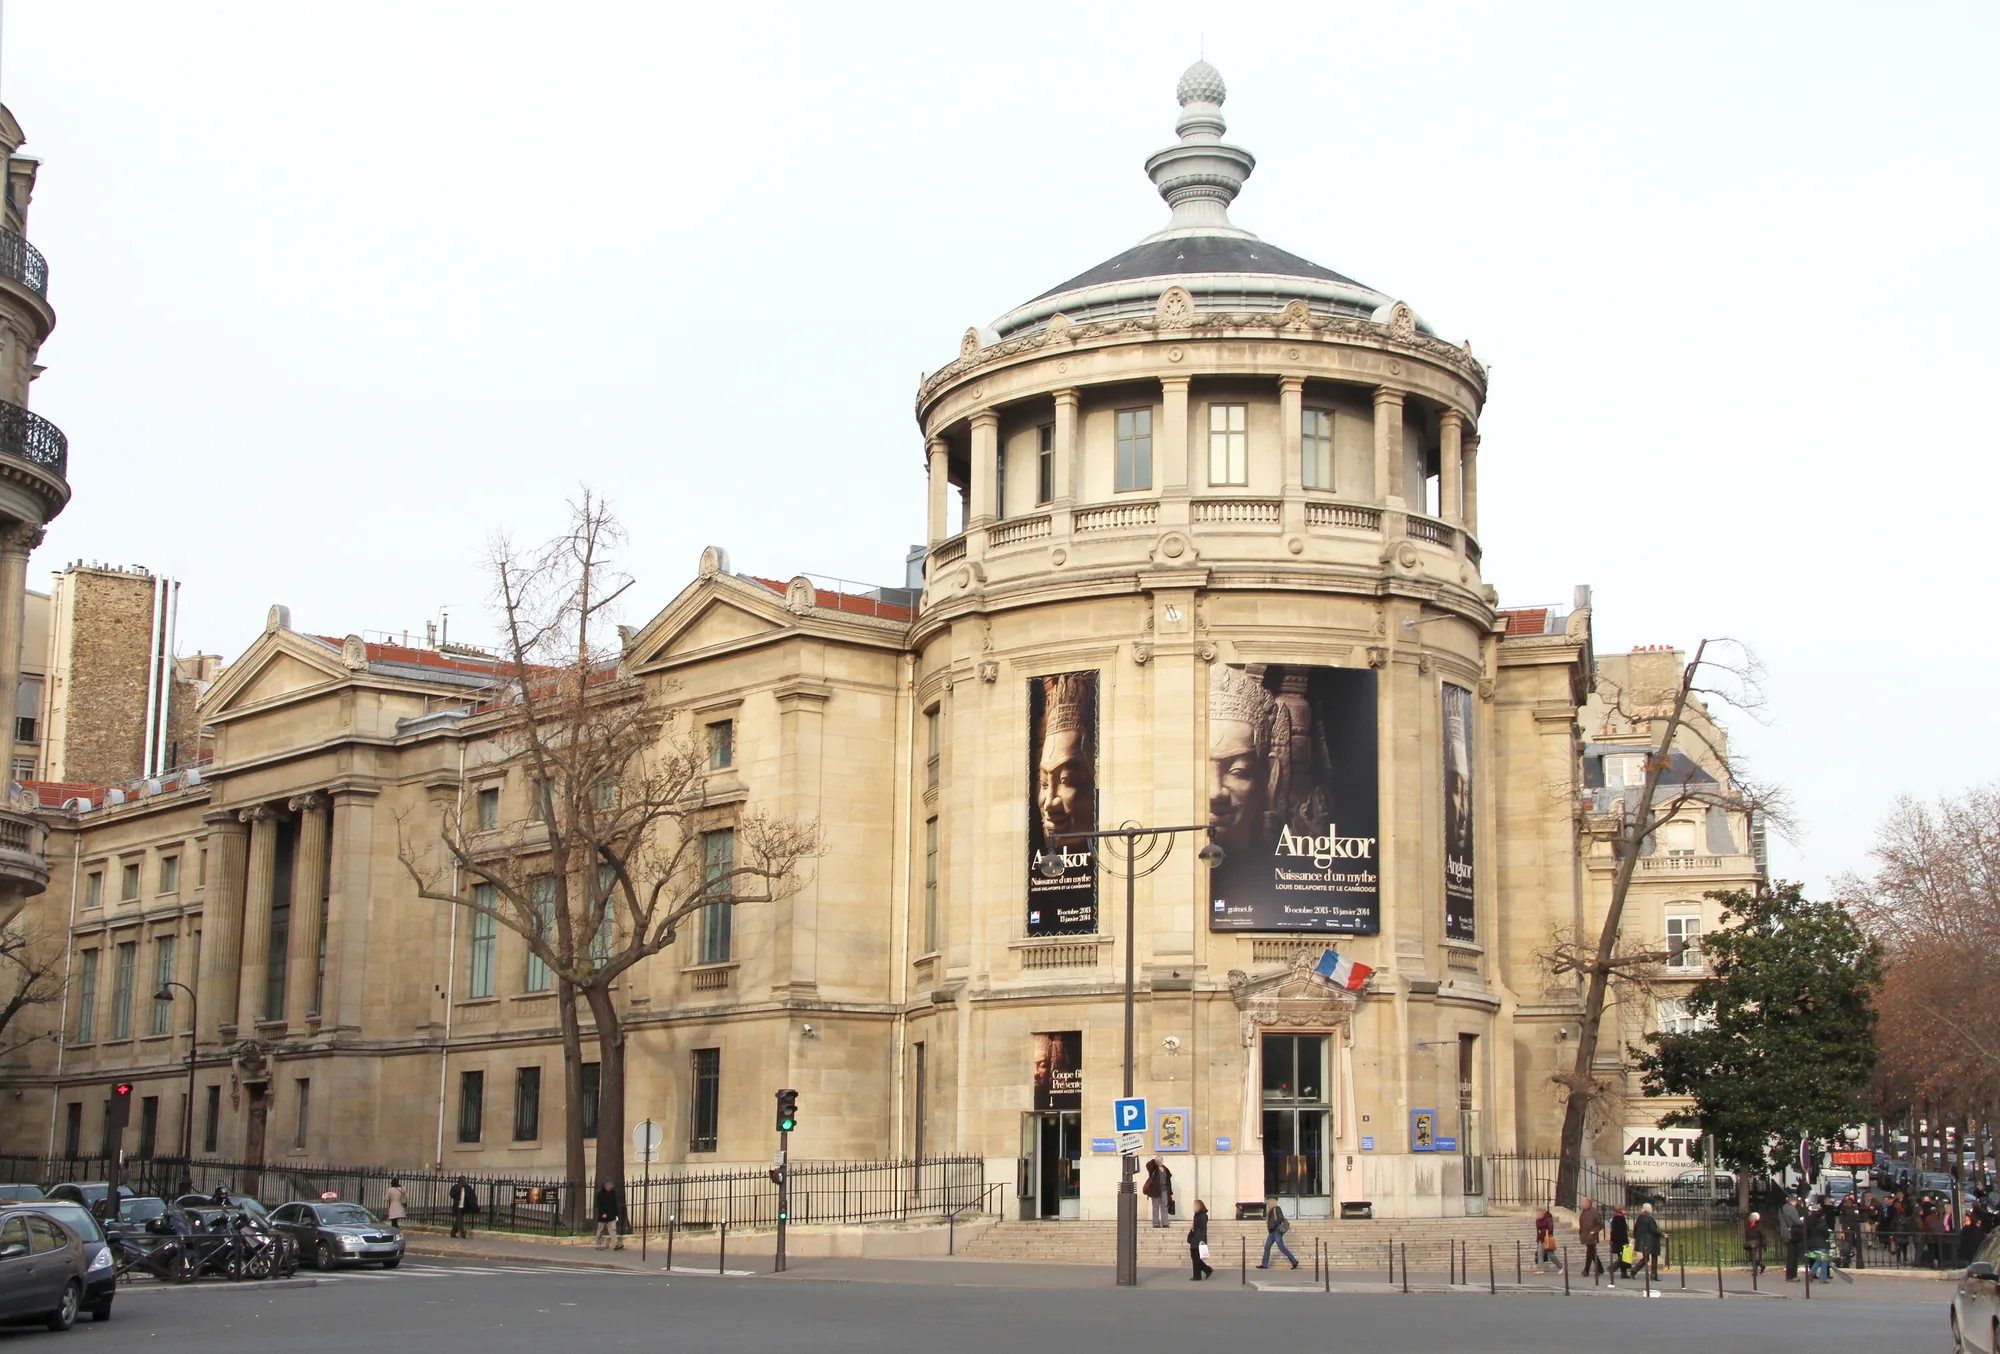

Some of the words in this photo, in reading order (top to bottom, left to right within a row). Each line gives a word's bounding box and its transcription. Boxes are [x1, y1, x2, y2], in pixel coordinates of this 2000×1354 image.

[1274, 823, 1376, 869] Angkor
[1031, 846, 1091, 875] Akor
[1447, 854, 1472, 883] Angkor
[1031, 877, 1058, 886] Naissance
[1072, 874, 1091, 885] mythe
[1275, 867, 1322, 881] Naissance
[1324, 868, 1345, 882] d'un
[1347, 870, 1376, 886] mythe
[1284, 905, 1291, 913] 16
[1292, 906, 1313, 914] octobre
[1313, 906, 1328, 914] 2013
[1332, 907, 1339, 915] 13
[1339, 907, 1356, 916] janvier
[1356, 908, 1370, 916] 2014
[1052, 1070, 1074, 1081] Coupe
[1123, 1105, 1138, 1127] P
